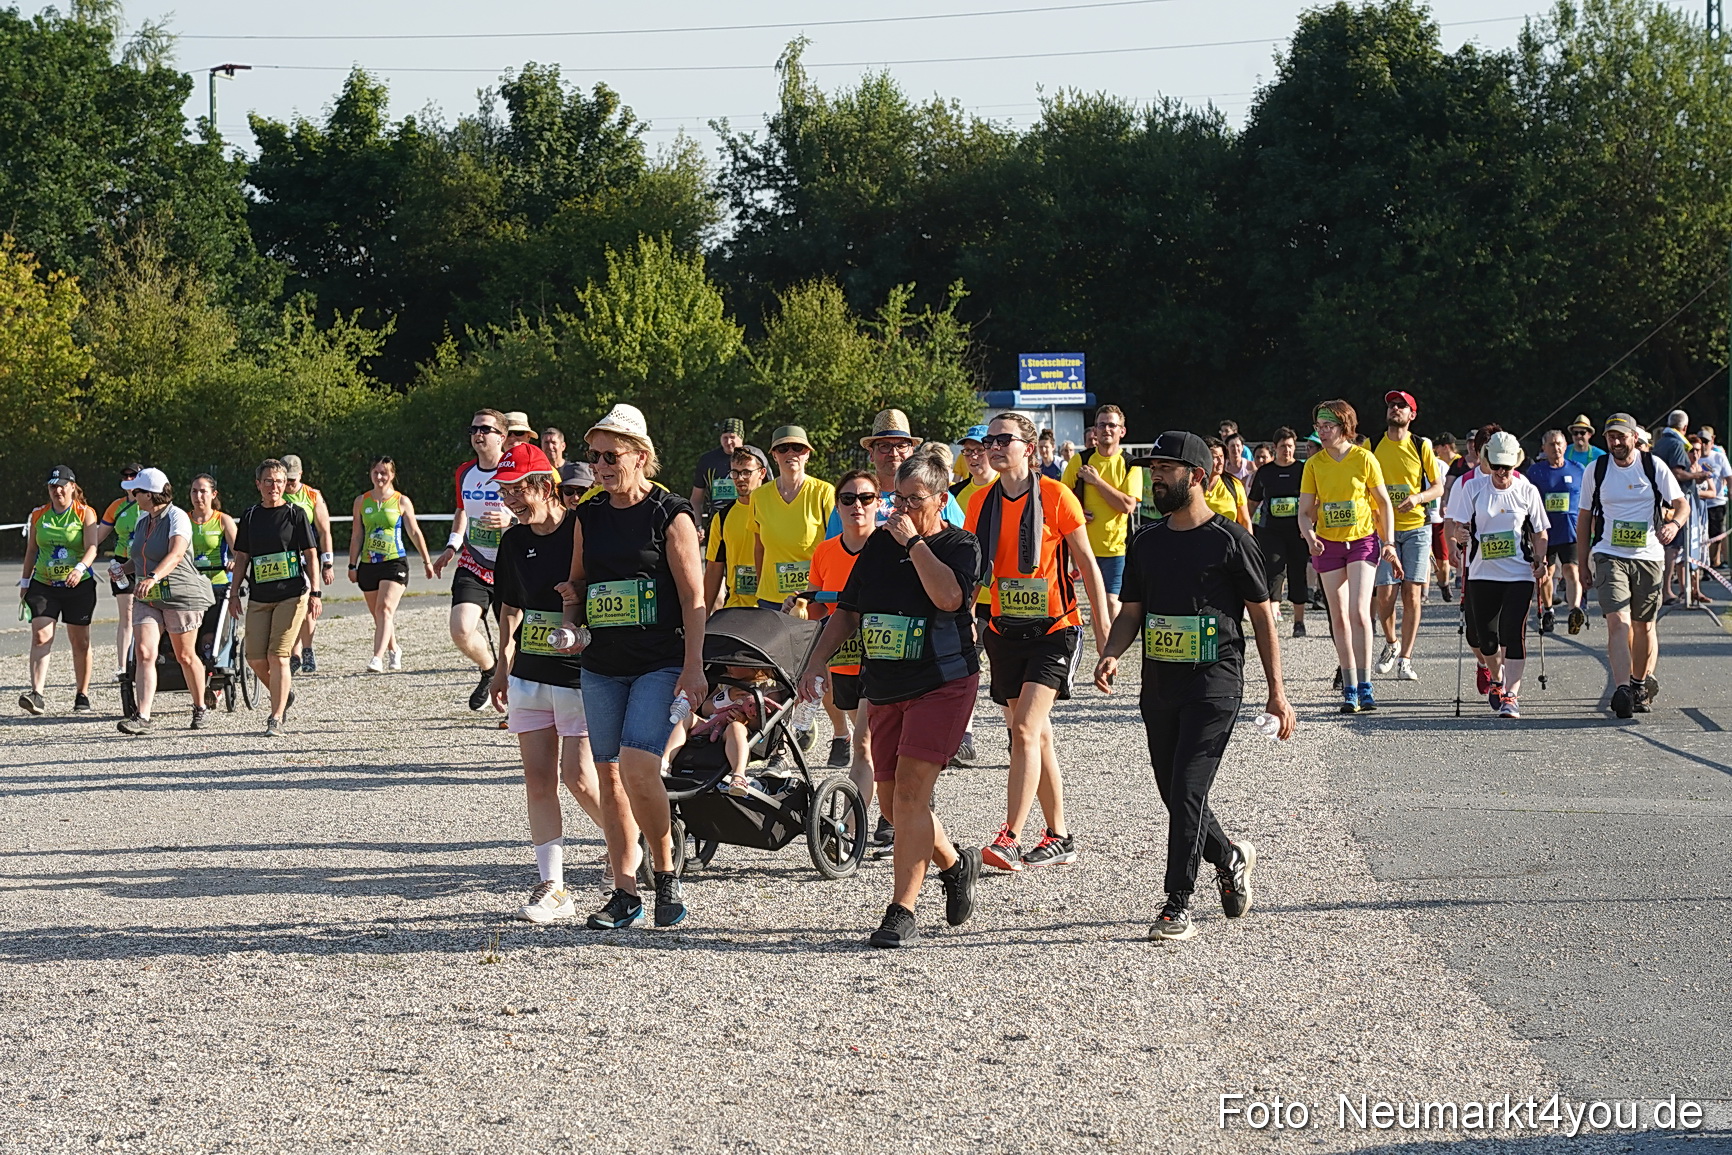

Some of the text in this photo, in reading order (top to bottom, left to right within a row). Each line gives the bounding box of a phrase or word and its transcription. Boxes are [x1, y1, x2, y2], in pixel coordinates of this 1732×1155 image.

[1021, 359, 1027, 367] 1.
[1041, 370, 1063, 378] verein
[1328, 509, 1351, 520] 1266
[476, 531, 492, 540] 327
[1617, 530, 1642, 539] 1324
[372, 539, 386, 548] 593
[1020, 529, 1029, 564] FIT-FLIP
[1486, 540, 1510, 551] 1322
[54, 565, 70, 574] 625
[261, 563, 279, 574] 274
[1005, 591, 1040, 605] 1408
[596, 597, 623, 613] 303
[867, 629, 892, 644] 276
[1154, 631, 1184, 647] 267
[896, 633, 904, 654] 2022
